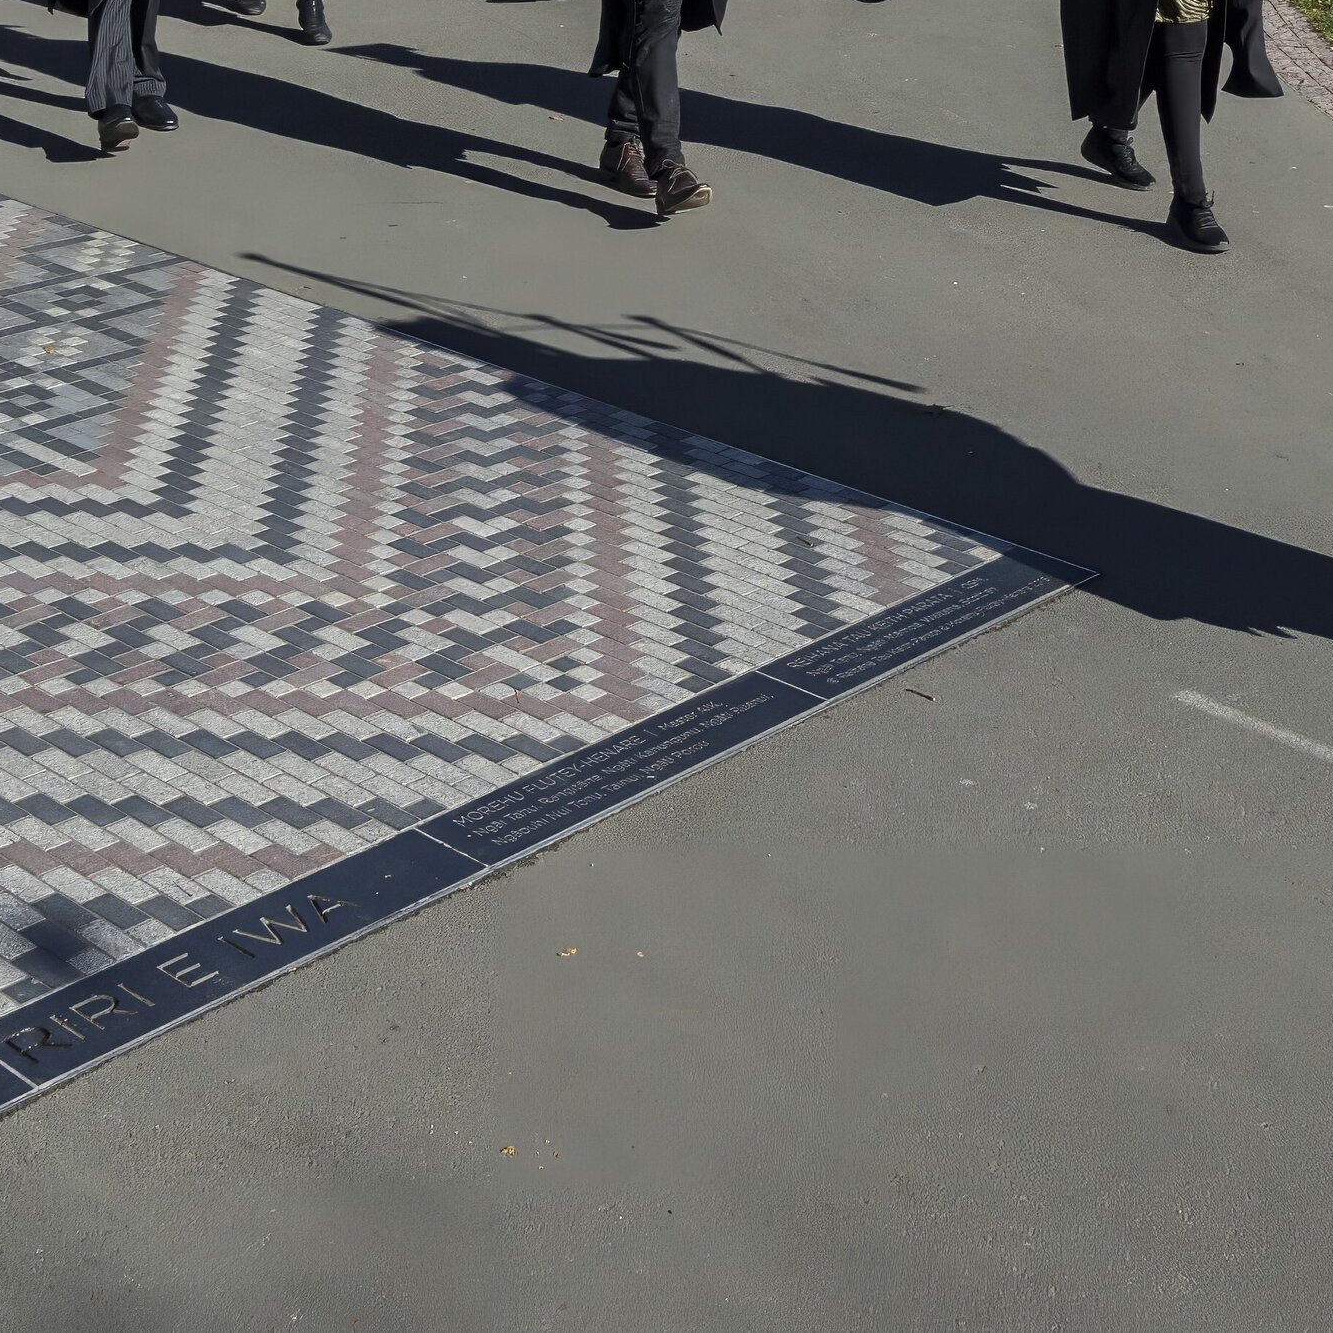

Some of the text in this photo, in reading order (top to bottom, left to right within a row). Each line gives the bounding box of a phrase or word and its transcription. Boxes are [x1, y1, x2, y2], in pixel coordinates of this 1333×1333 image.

[449, 790, 529, 828] MOREHU
[519, 733, 649, 795] FLUTEY-HENARE
[157, 952, 220, 988] E
[217, 894, 361, 959] IWA
